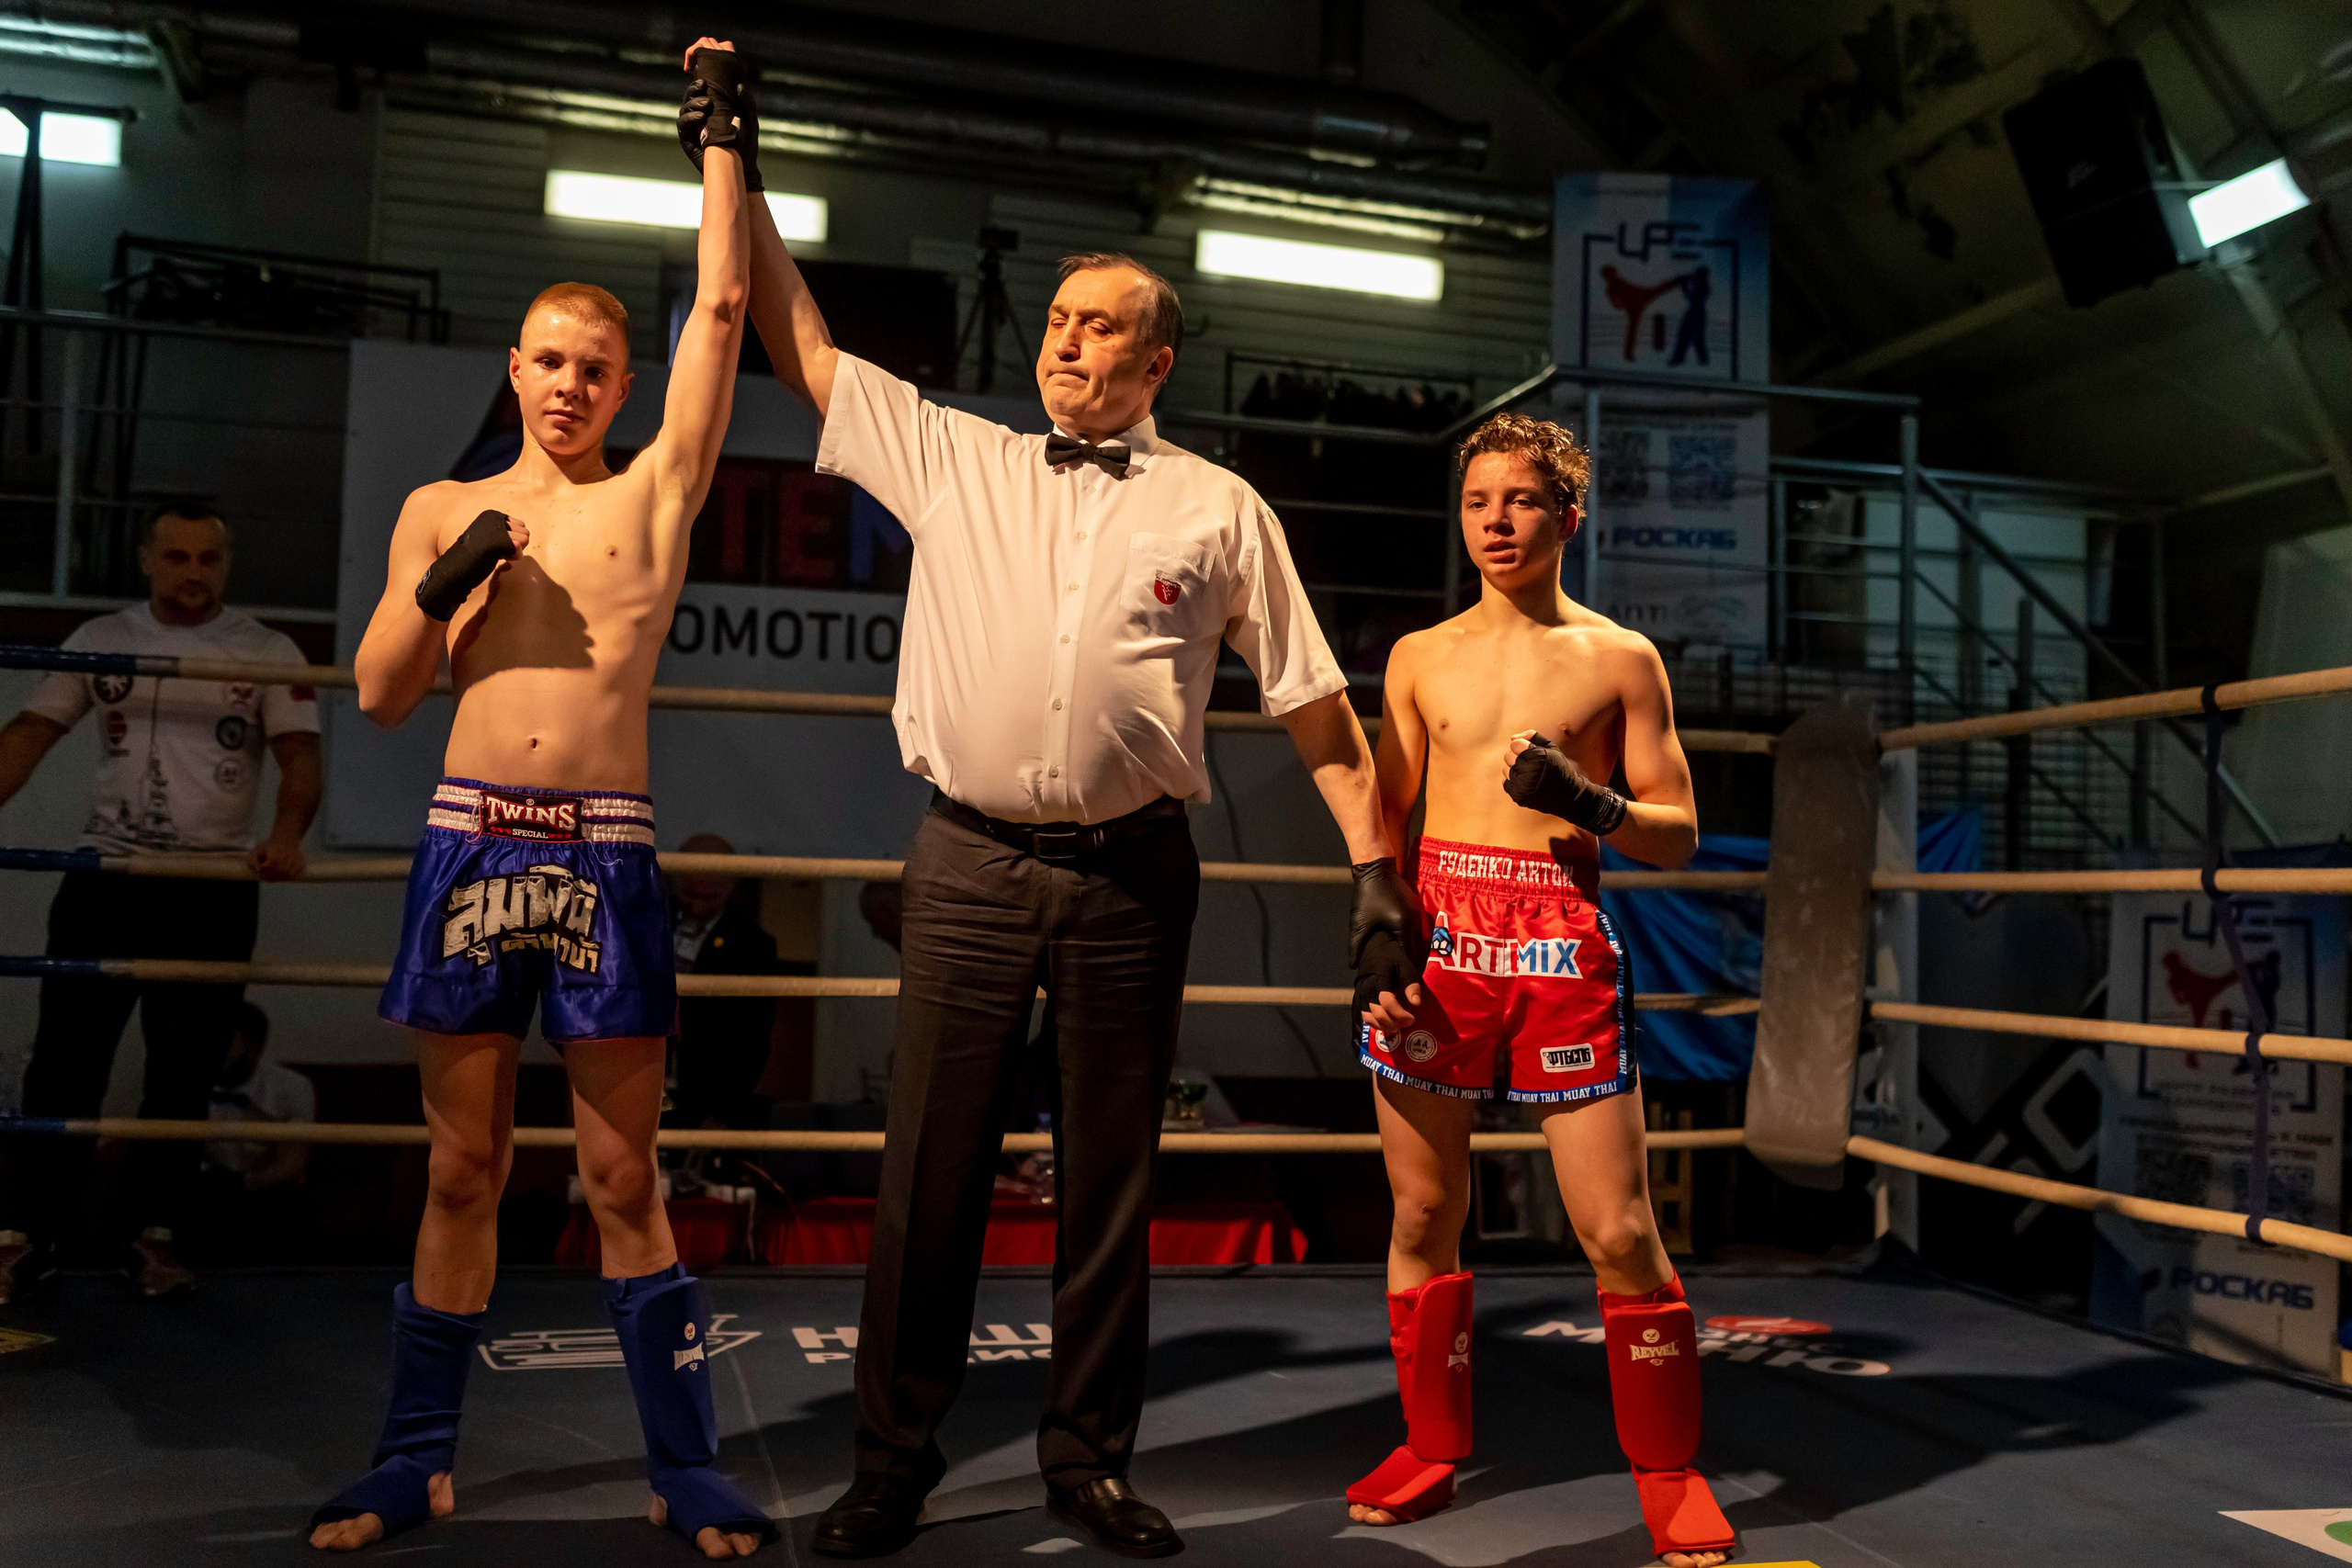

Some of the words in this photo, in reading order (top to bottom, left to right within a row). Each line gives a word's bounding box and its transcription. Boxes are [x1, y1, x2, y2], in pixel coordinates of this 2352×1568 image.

[512, 829, 549, 839] SPECIAL
[1360, 1054, 1383, 1072] MUAY
[1382, 1066, 1405, 1084] THAI
[1405, 1076, 1433, 1092] MUAY
[1435, 1084, 1459, 1099] THAI
[1460, 1089, 1484, 1100] MUAY
[1540, 1091, 1559, 1102] THAI
[1563, 1087, 1591, 1101] MUAY
[1593, 1081, 1618, 1094] THAI
[2172, 1267, 2314, 1310] РОСКАБ
